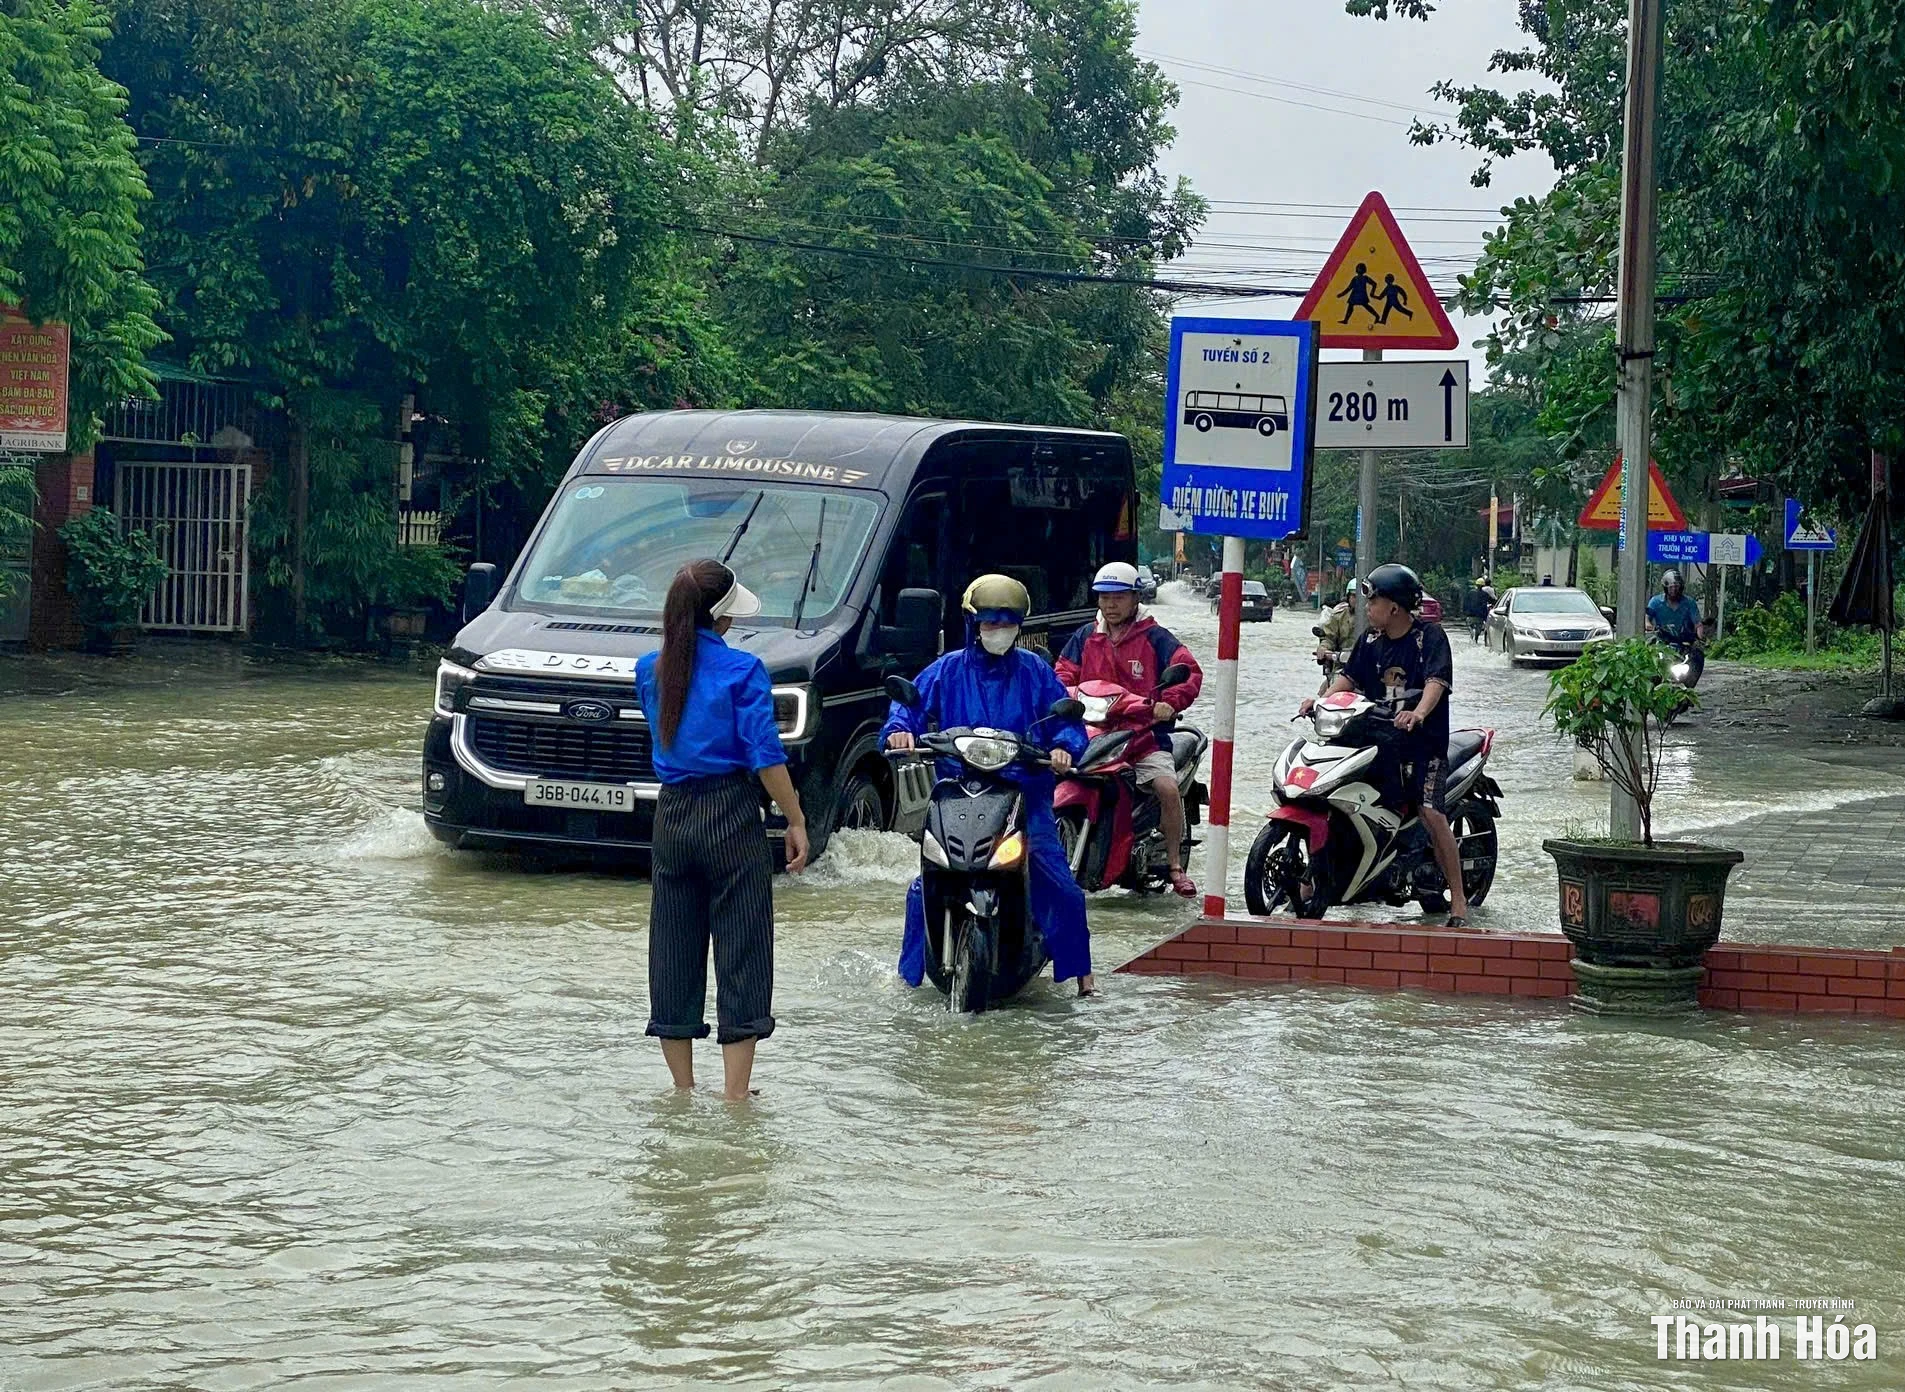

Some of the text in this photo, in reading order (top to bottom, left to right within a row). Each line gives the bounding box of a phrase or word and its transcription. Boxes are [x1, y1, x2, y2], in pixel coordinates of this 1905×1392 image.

[1202, 346, 1270, 364] TUYẾN SỐ 2
[30, 370, 50, 382] NAM
[1328, 391, 1409, 422] 280 m
[4, 438, 62, 448] AGRIBANK
[624, 455, 838, 481] DCAR LIMOUSINE
[1172, 474, 1289, 521] ĐIỂM DỪNG XE BUÝT
[1663, 534, 1678, 542] KHU
[542, 655, 635, 672] DCA
[575, 705, 602, 719] Ford
[535, 784, 625, 806] 36B-044.19
